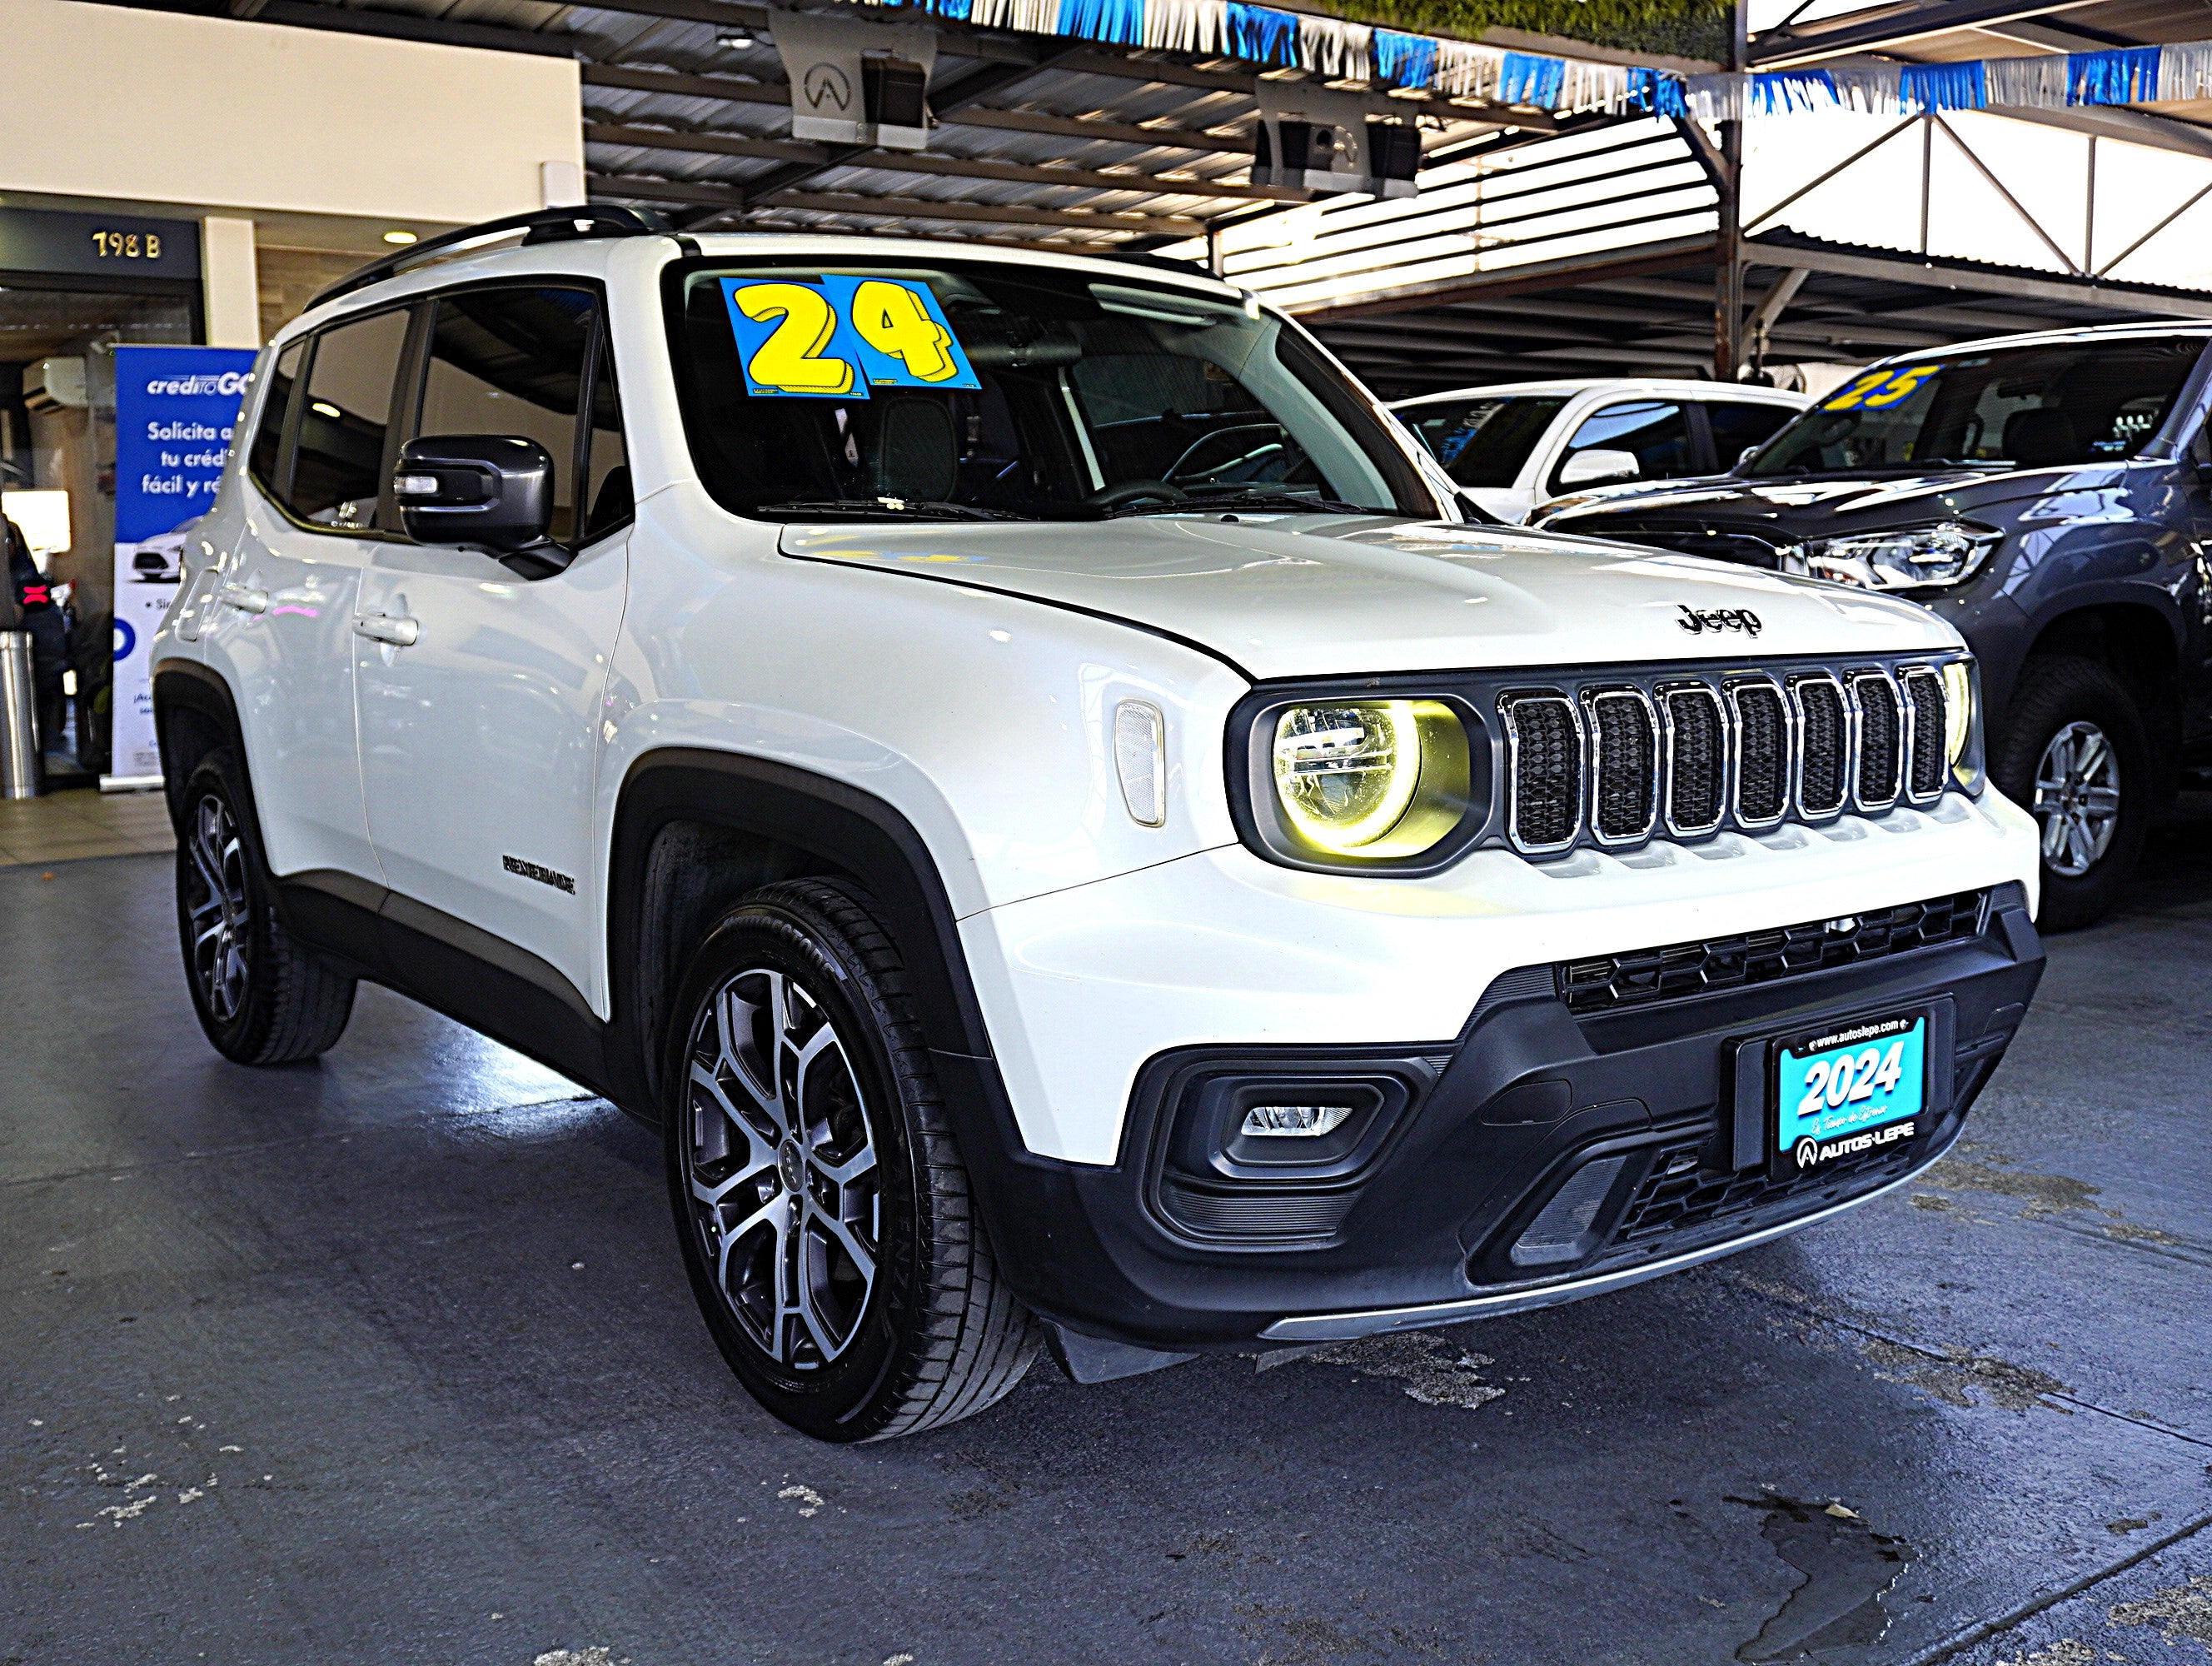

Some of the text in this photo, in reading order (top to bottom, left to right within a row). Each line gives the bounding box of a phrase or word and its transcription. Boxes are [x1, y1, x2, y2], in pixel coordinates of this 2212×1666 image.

[145, 233, 162, 258] B
[1823, 365, 1940, 412] 25
[147, 421, 217, 441] Solicita
[161, 451, 180, 467] tu
[142, 474, 183, 494] fácil
[187, 480, 201, 499] y
[1674, 605, 1762, 639] Jeep
[1816, 1020, 1899, 1049] www.autoslepe.com
[1797, 1040, 1905, 1116] 2024
